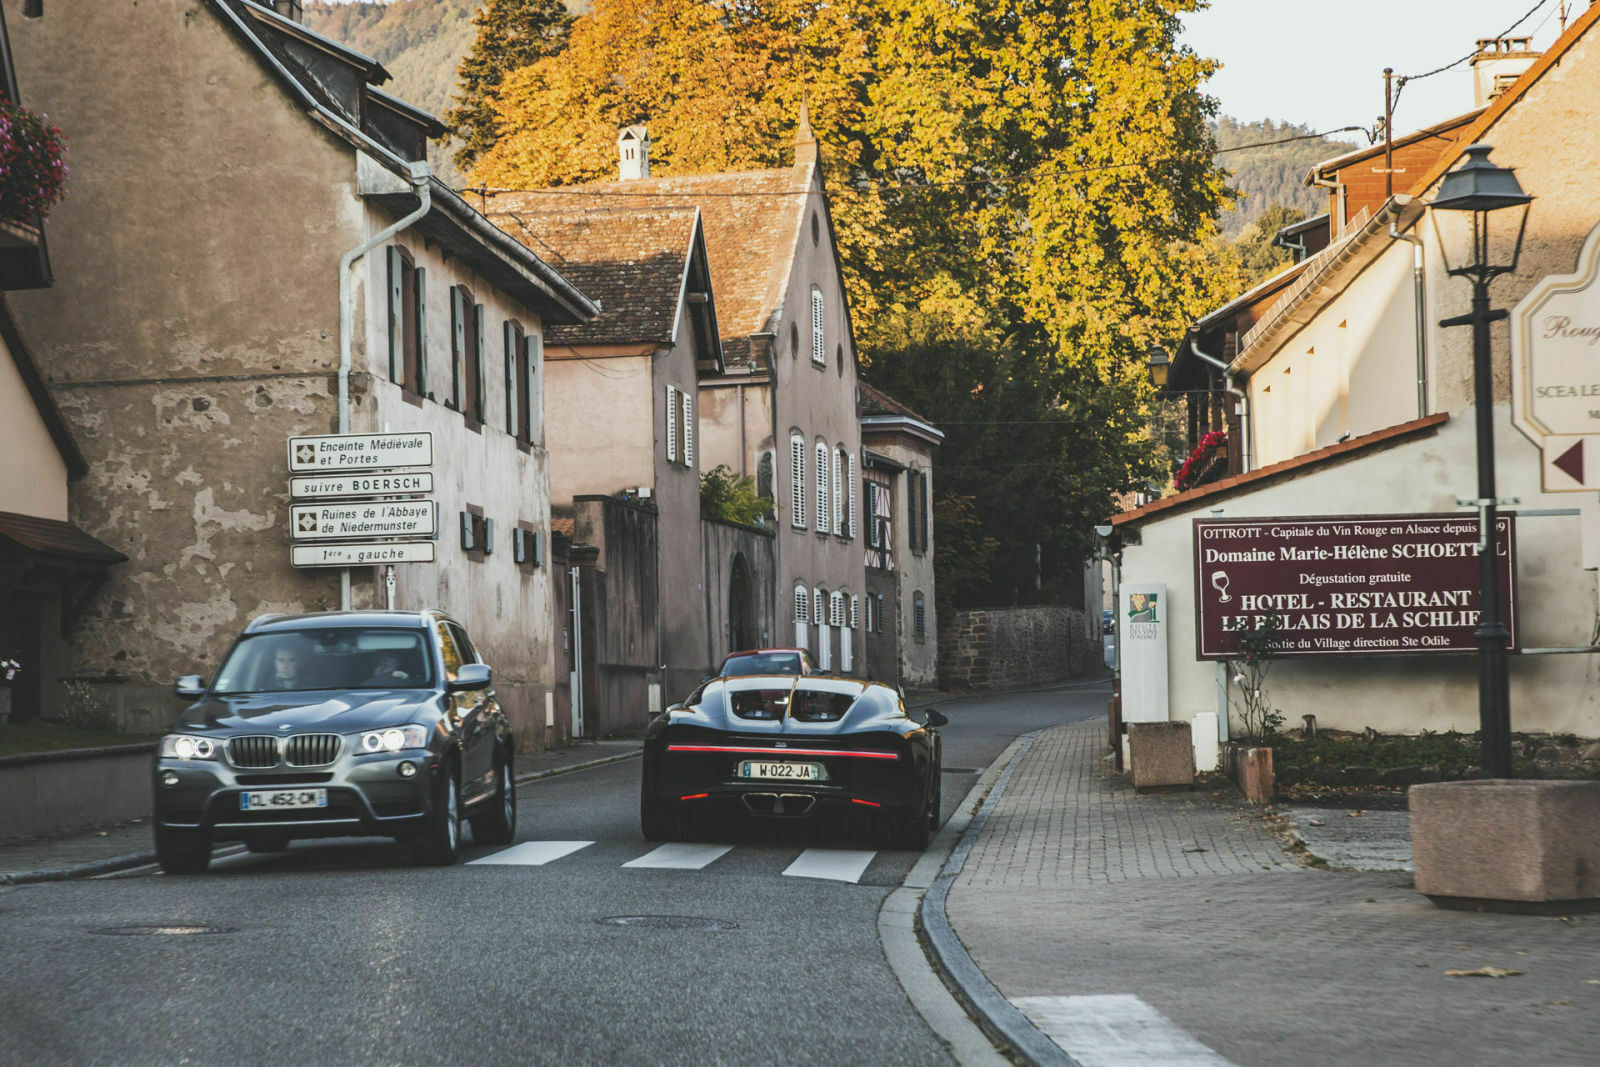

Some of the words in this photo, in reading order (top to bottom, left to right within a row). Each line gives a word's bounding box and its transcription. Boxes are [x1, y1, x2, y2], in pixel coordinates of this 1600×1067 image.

[320, 441, 364, 452] Enceinte
[370, 438, 423, 450] Médiévale
[320, 456, 332, 465] et
[339, 454, 378, 464] Portes
[304, 482, 343, 493] suivre
[352, 478, 420, 490] BOERSCH
[321, 509, 357, 520] Ruines
[363, 508, 376, 519] de
[381, 506, 428, 519] l'Abbaye
[321, 523, 334, 533] de
[340, 520, 417, 532] Niedermunster
[1203, 527, 1262, 539] OTTROTT
[1271, 526, 1314, 539] Capitale
[1316, 526, 1330, 536] du
[1332, 525, 1351, 536] Vin
[1354, 525, 1387, 537] Rouge
[1390, 526, 1403, 534] en
[1405, 523, 1440, 534] Alsace
[1443, 522, 1478, 535] depuis
[358, 549, 404, 563] gauche
[1205, 548, 1275, 563] Domaine
[1280, 544, 1388, 561] Marie-Hélène
[1392, 542, 1507, 558] SCHOETTL
[1300, 572, 1366, 586] Dégustation
[1369, 571, 1411, 585] gratuite
[1241, 593, 1314, 611] HOTEL
[1330, 590, 1472, 609] RESTAURANT
[1221, 615, 1249, 631] LE
[1336, 612, 1365, 629] DE
[1370, 612, 1399, 629] LA
[1297, 638, 1311, 648] du
[1313, 637, 1350, 650] Village
[1353, 637, 1399, 647] direction
[1402, 636, 1418, 646] Ste
[1421, 635, 1450, 646] Odile
